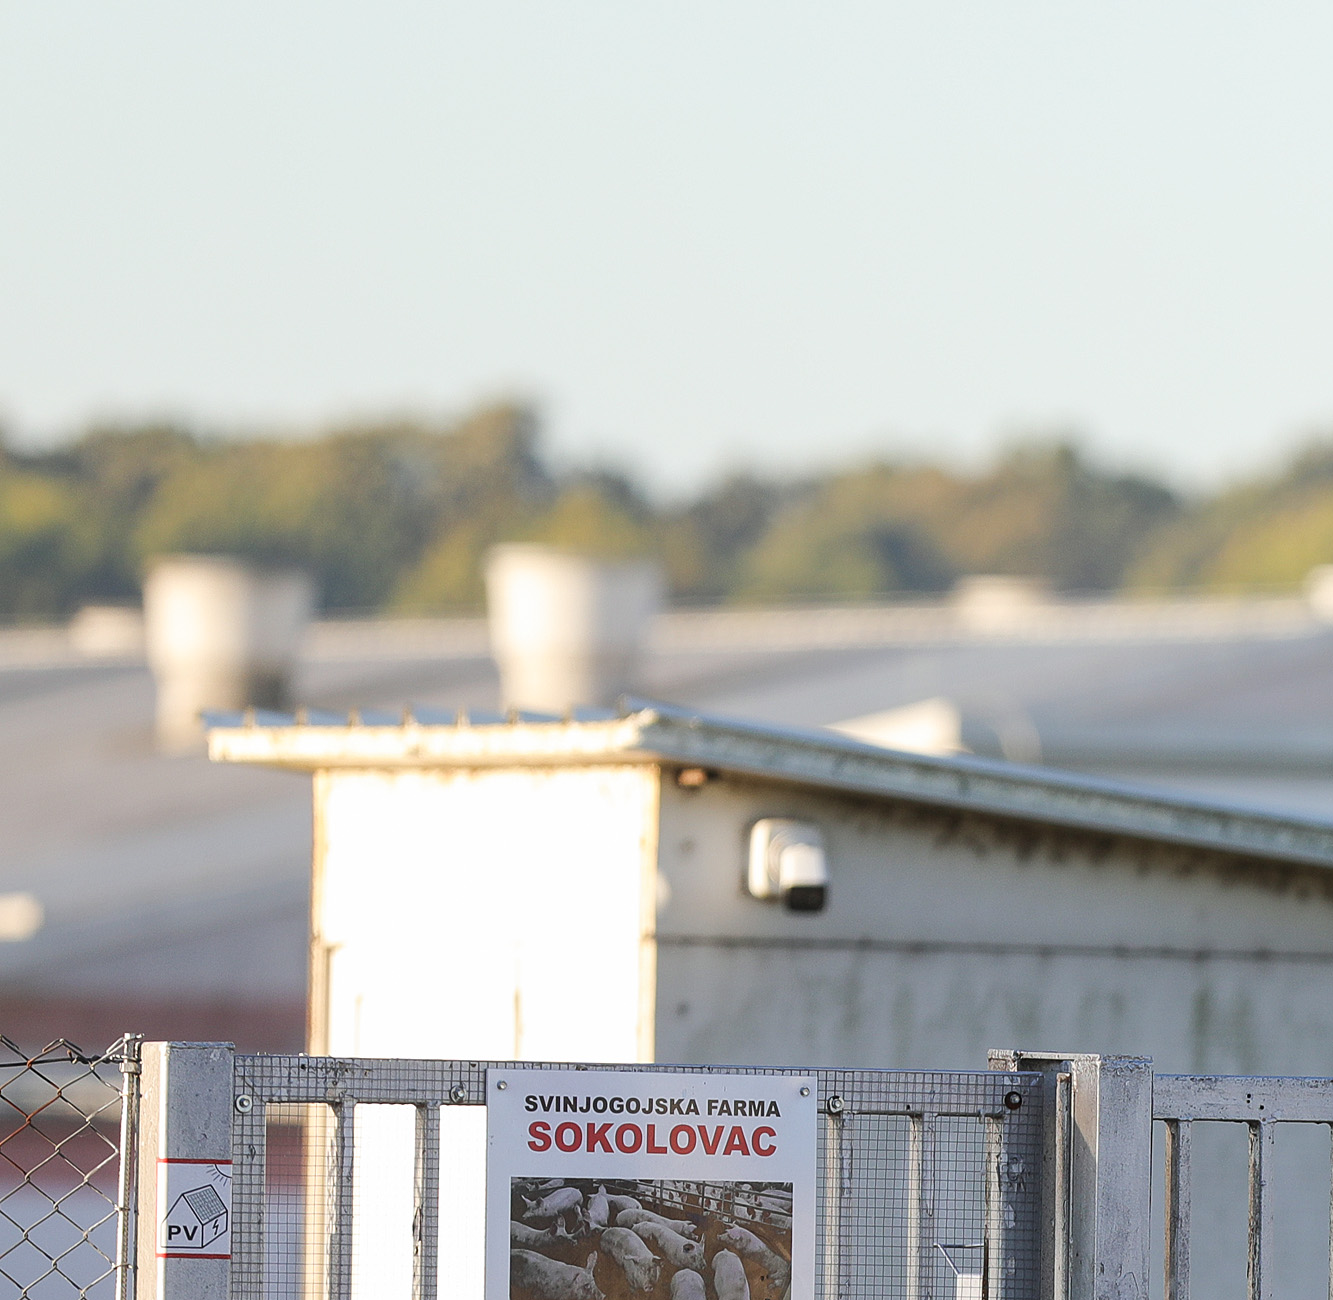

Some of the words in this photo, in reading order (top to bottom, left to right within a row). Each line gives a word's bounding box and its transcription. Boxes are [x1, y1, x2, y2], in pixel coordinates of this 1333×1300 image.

[524, 1095, 700, 1115] SVINJOGOJSKA
[707, 1099, 780, 1117] FARMA
[528, 1121, 776, 1156] SOKOLOVAC
[168, 1225, 198, 1240] PV
